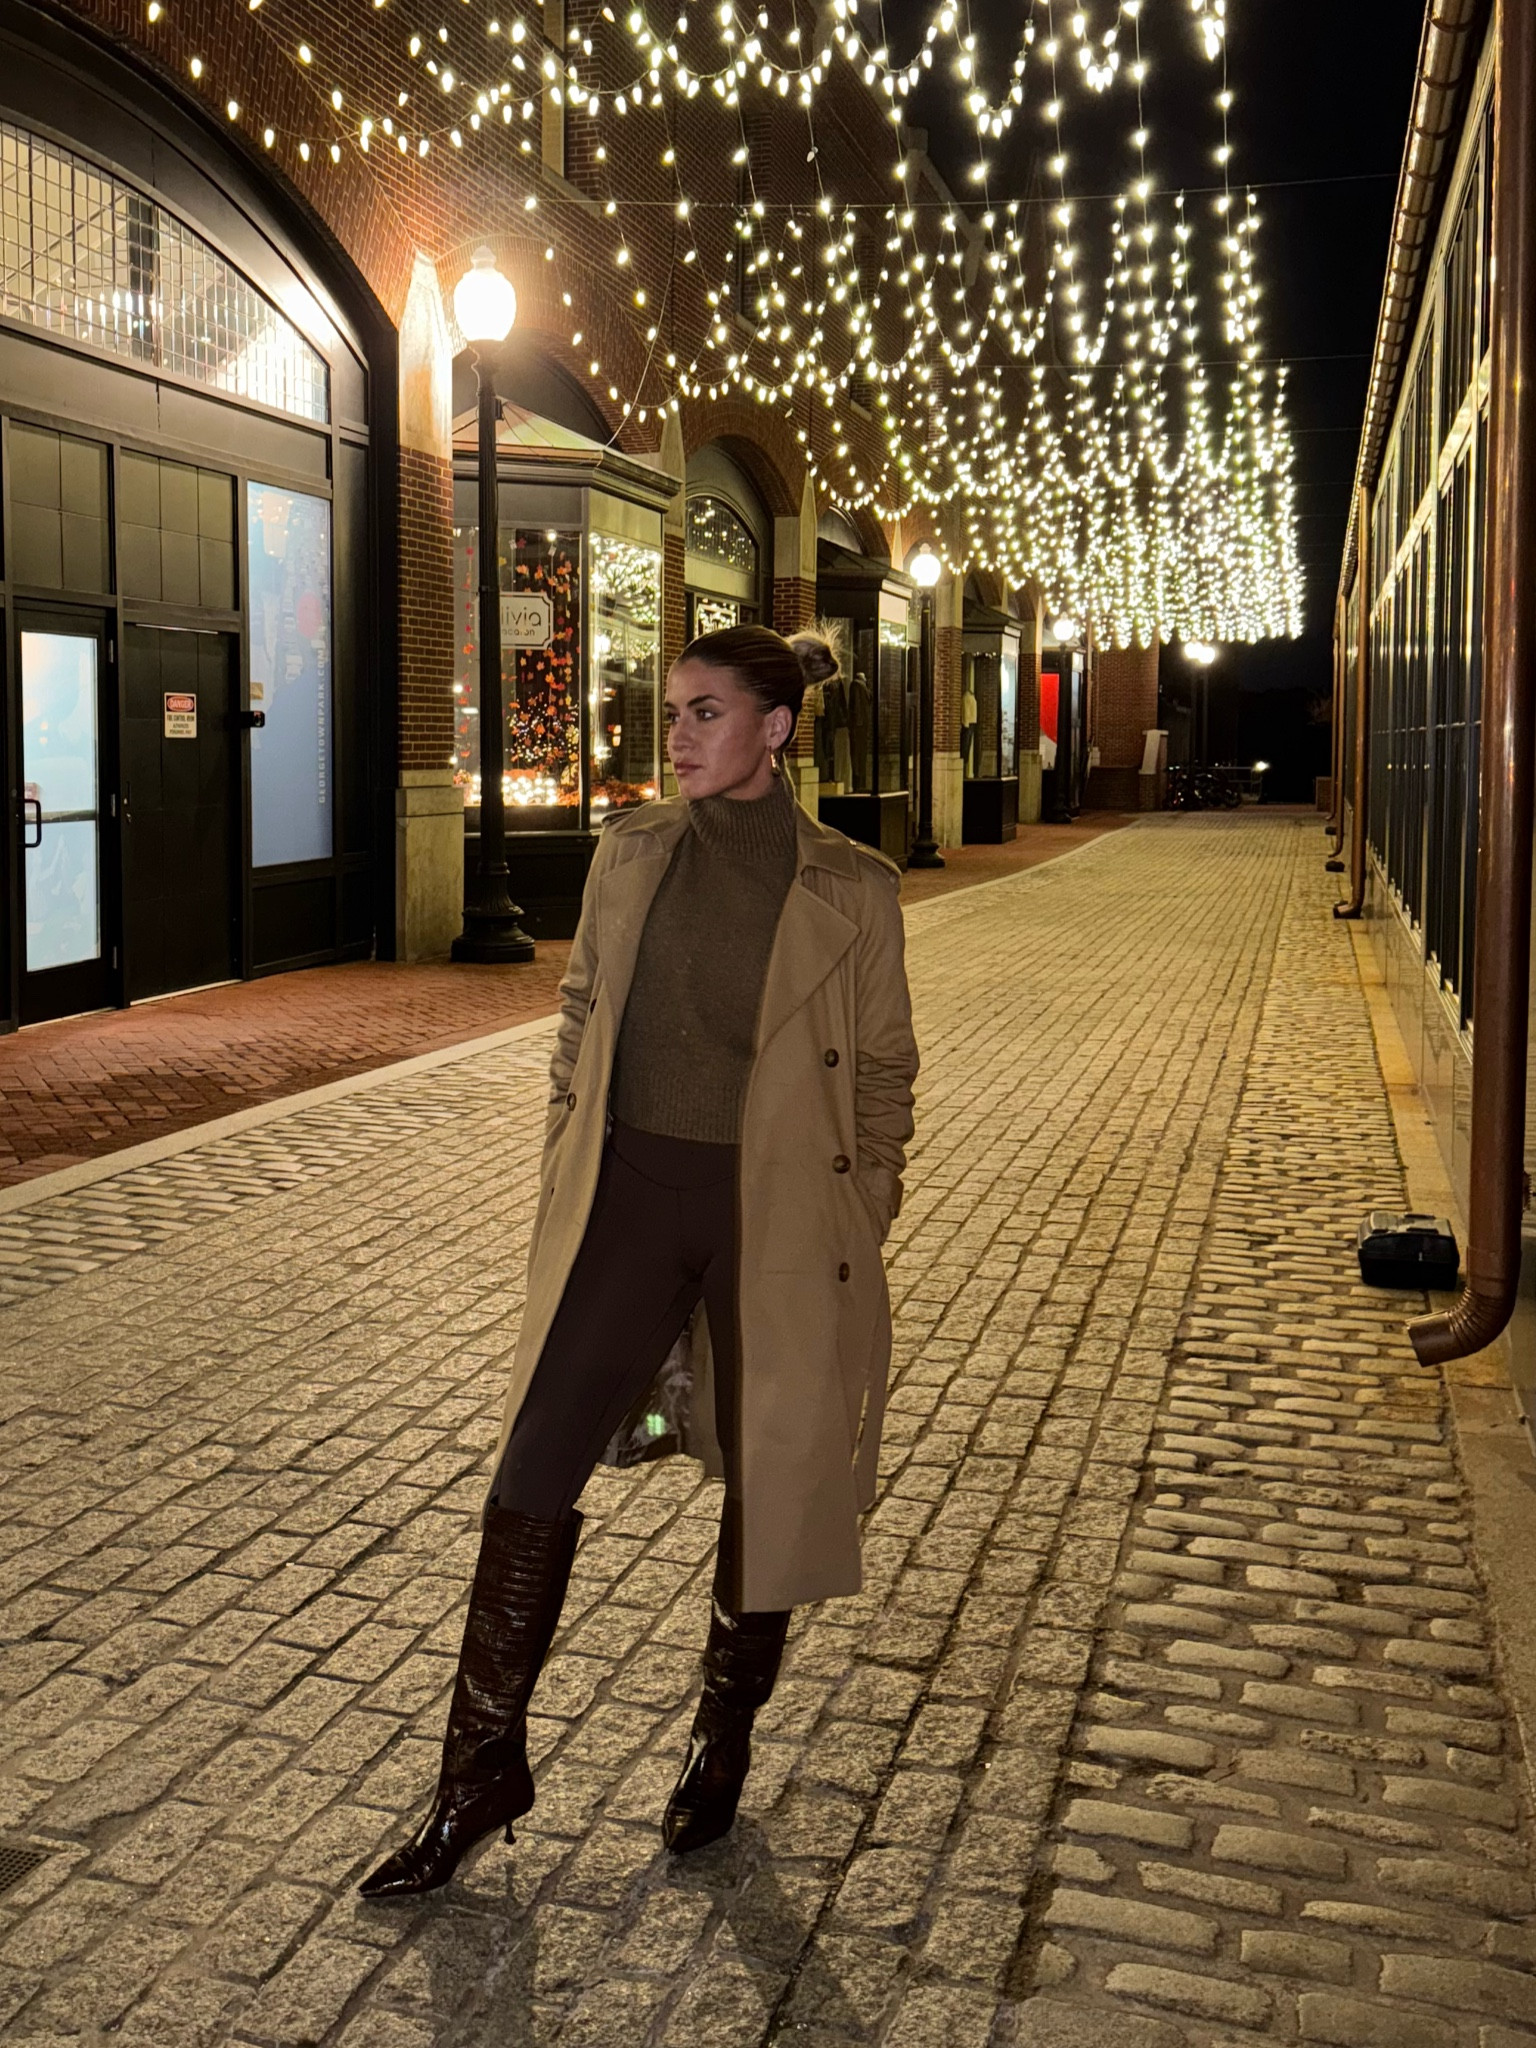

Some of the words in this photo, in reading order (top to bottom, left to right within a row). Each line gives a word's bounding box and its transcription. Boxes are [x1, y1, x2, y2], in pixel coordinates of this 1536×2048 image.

[501, 606, 541, 626] livia
[170, 699, 191, 709] DANGER
[317, 649, 326, 803] GEORGETOWNPARK.COM
